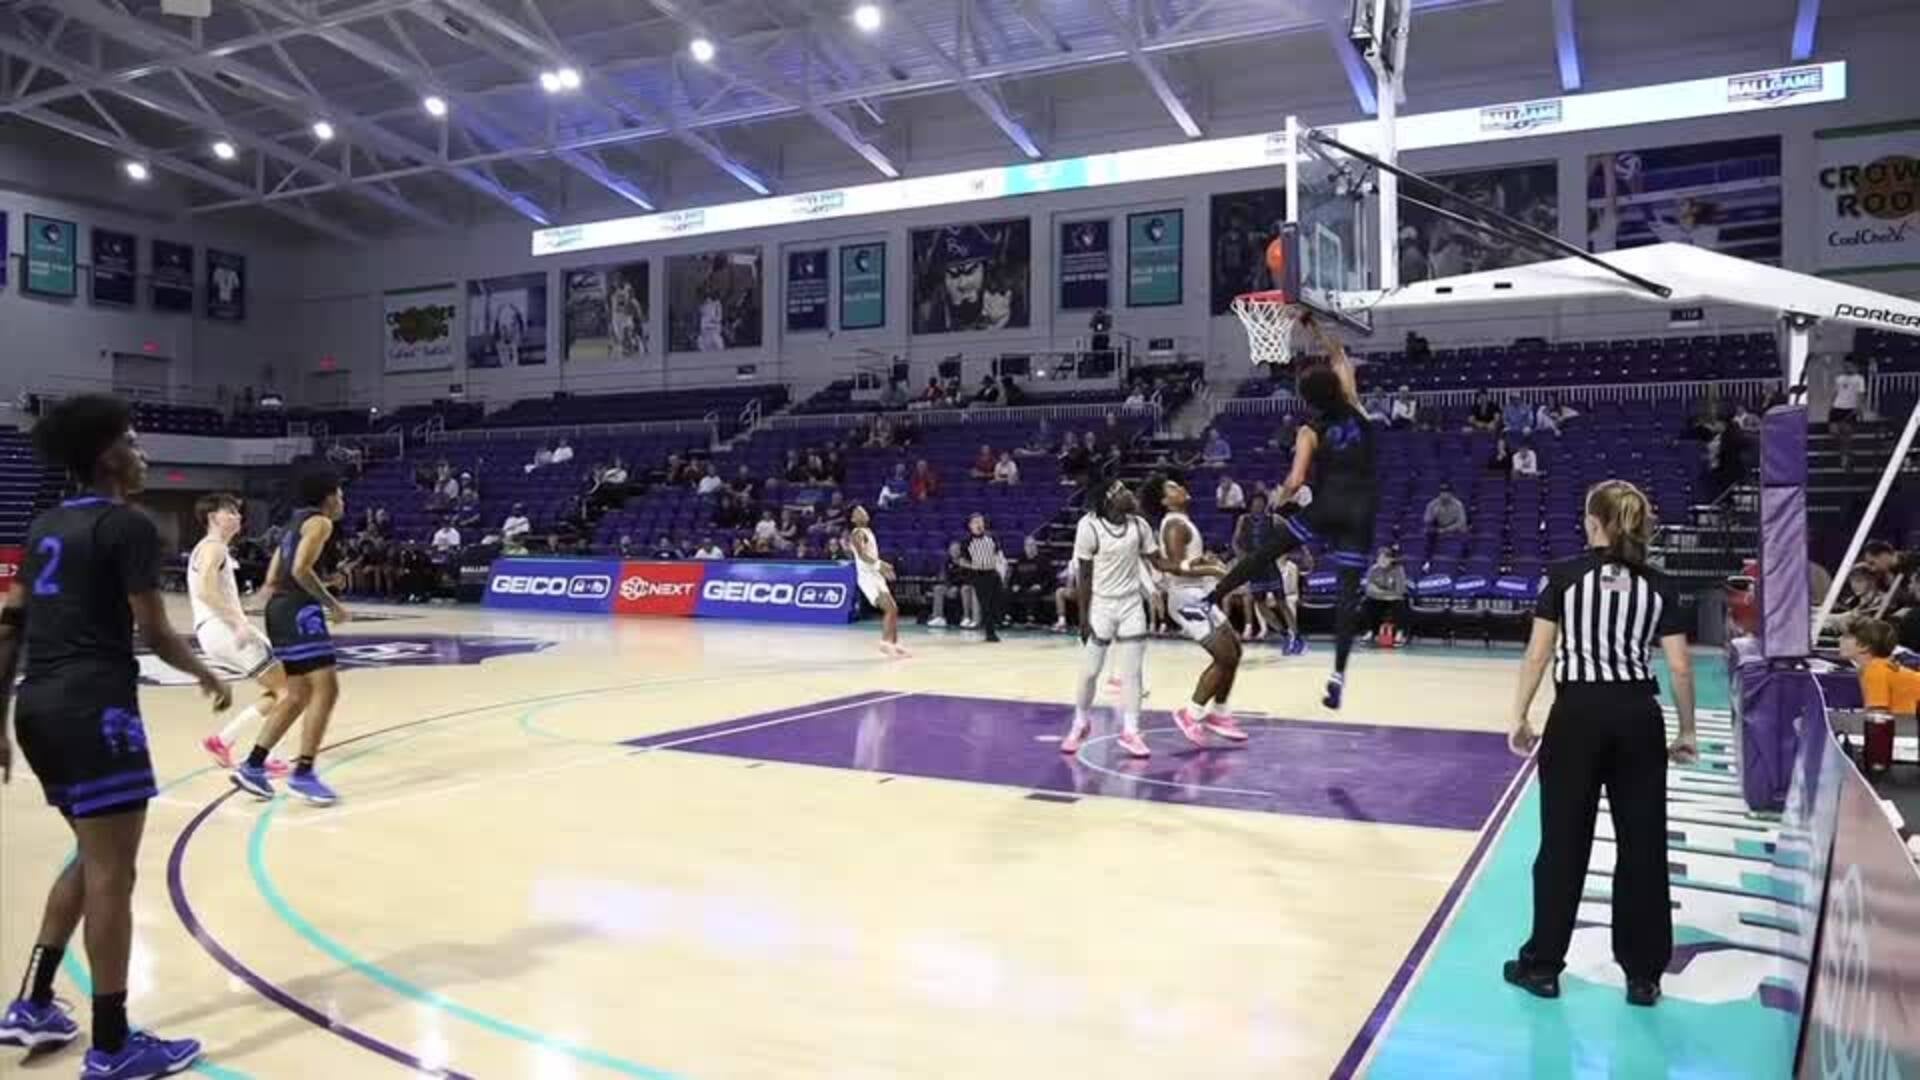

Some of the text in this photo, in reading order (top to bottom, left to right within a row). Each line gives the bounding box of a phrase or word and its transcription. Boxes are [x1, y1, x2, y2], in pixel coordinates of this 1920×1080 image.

[34, 535, 61, 595] 2
[491, 575, 567, 595] GEICO
[703, 580, 794, 604] GEICO
